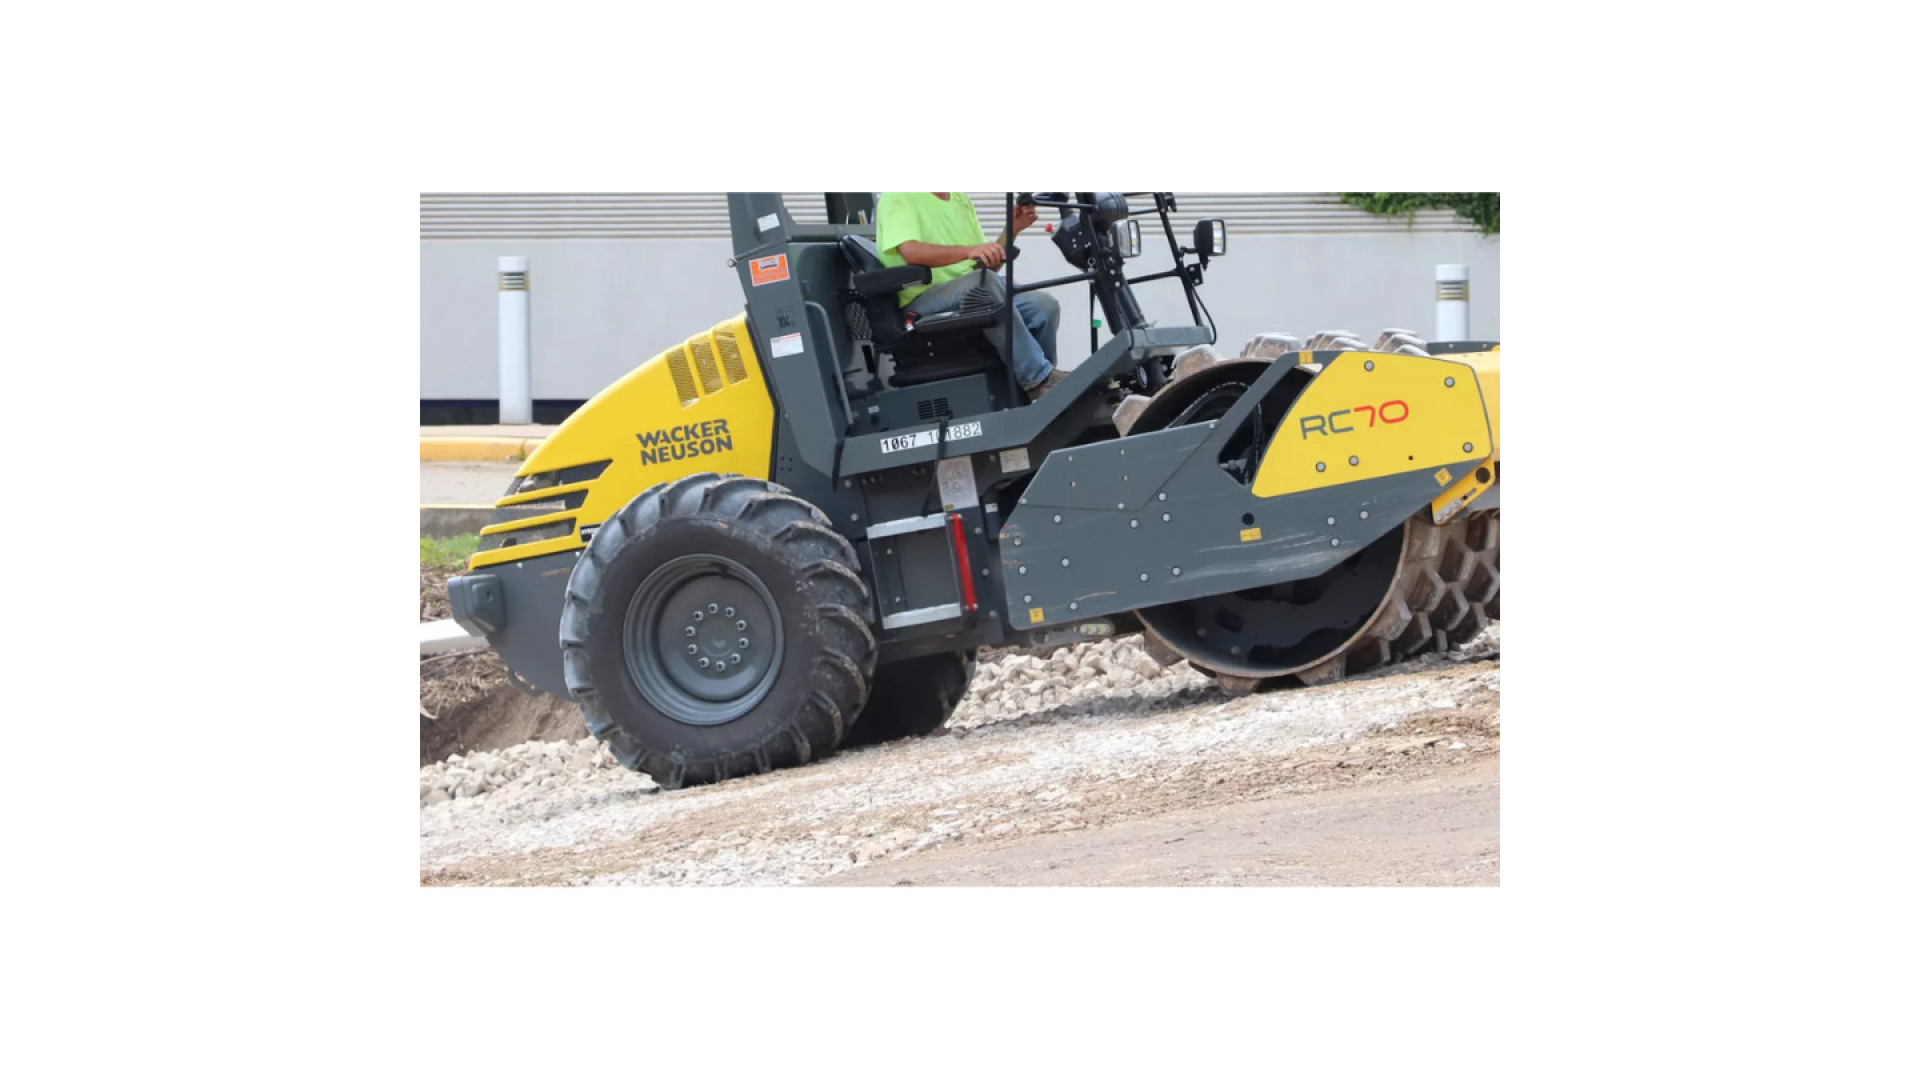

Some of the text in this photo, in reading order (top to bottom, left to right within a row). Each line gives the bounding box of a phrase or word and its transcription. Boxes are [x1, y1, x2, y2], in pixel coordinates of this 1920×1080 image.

[636, 418, 730, 448] WACKER
[1300, 400, 1409, 440] RC70
[640, 435, 732, 466] NEUSON
[882, 434, 917, 451] 1067
